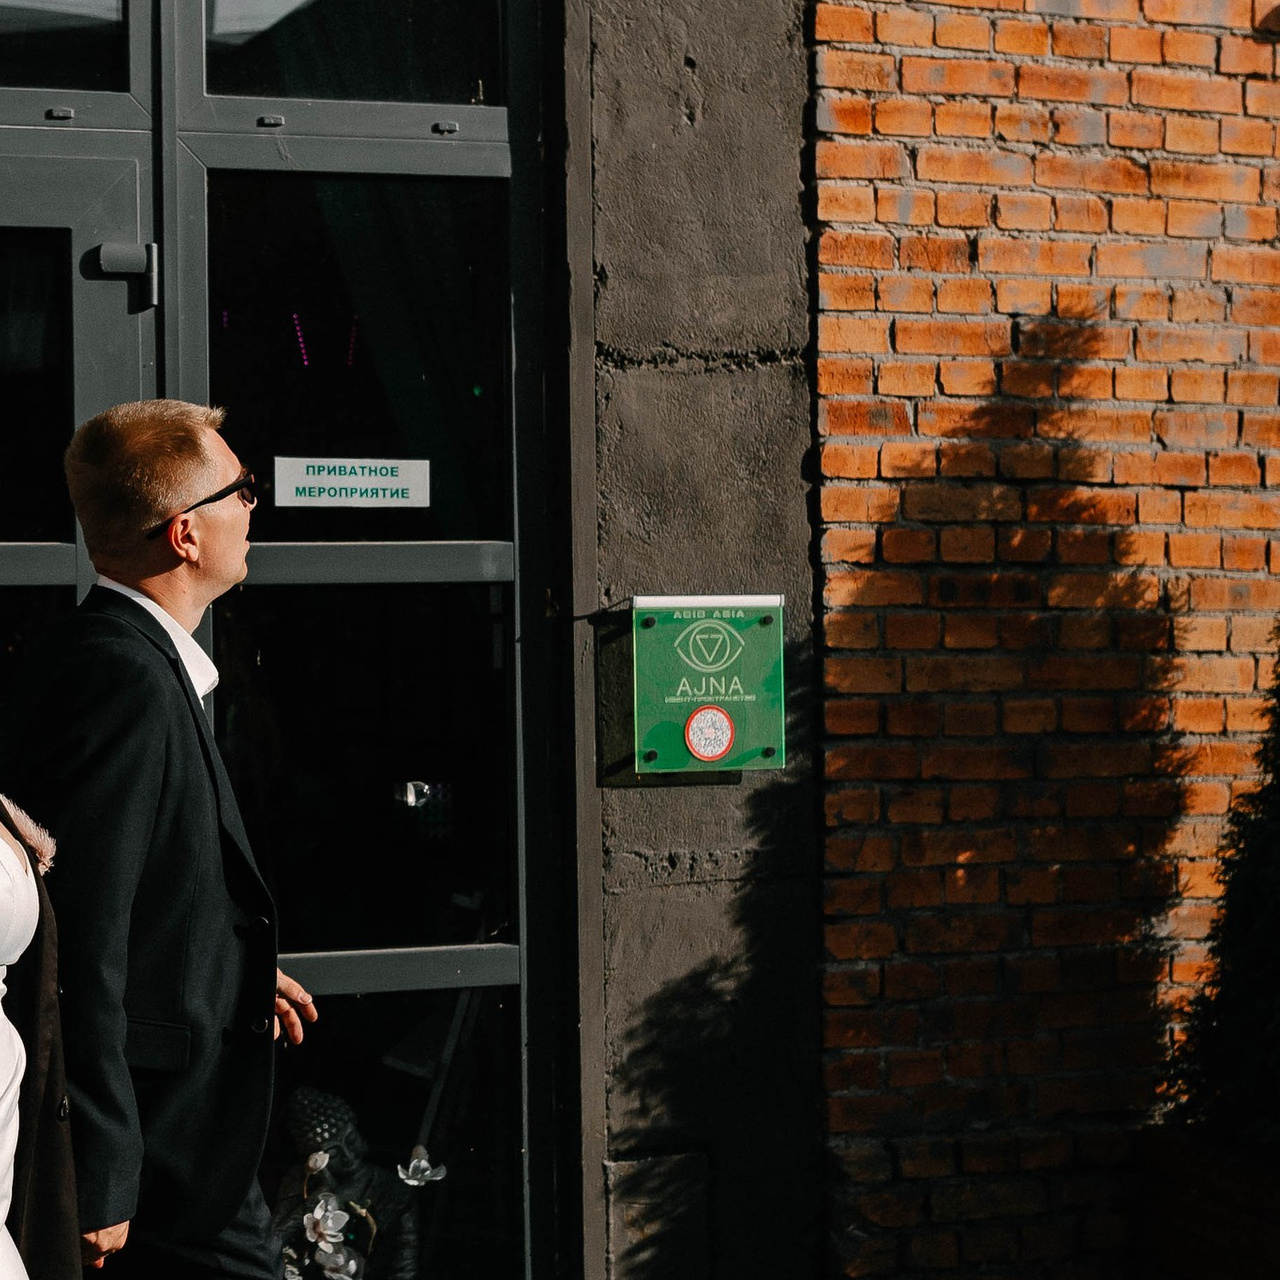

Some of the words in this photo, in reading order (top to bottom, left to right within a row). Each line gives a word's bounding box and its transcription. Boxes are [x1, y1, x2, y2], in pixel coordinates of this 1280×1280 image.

[305, 464, 399, 478] ПРИВАТНОЕ
[295, 486, 410, 499] МЕРОПРИЯТИЕ
[676, 675, 744, 695] AJNA
